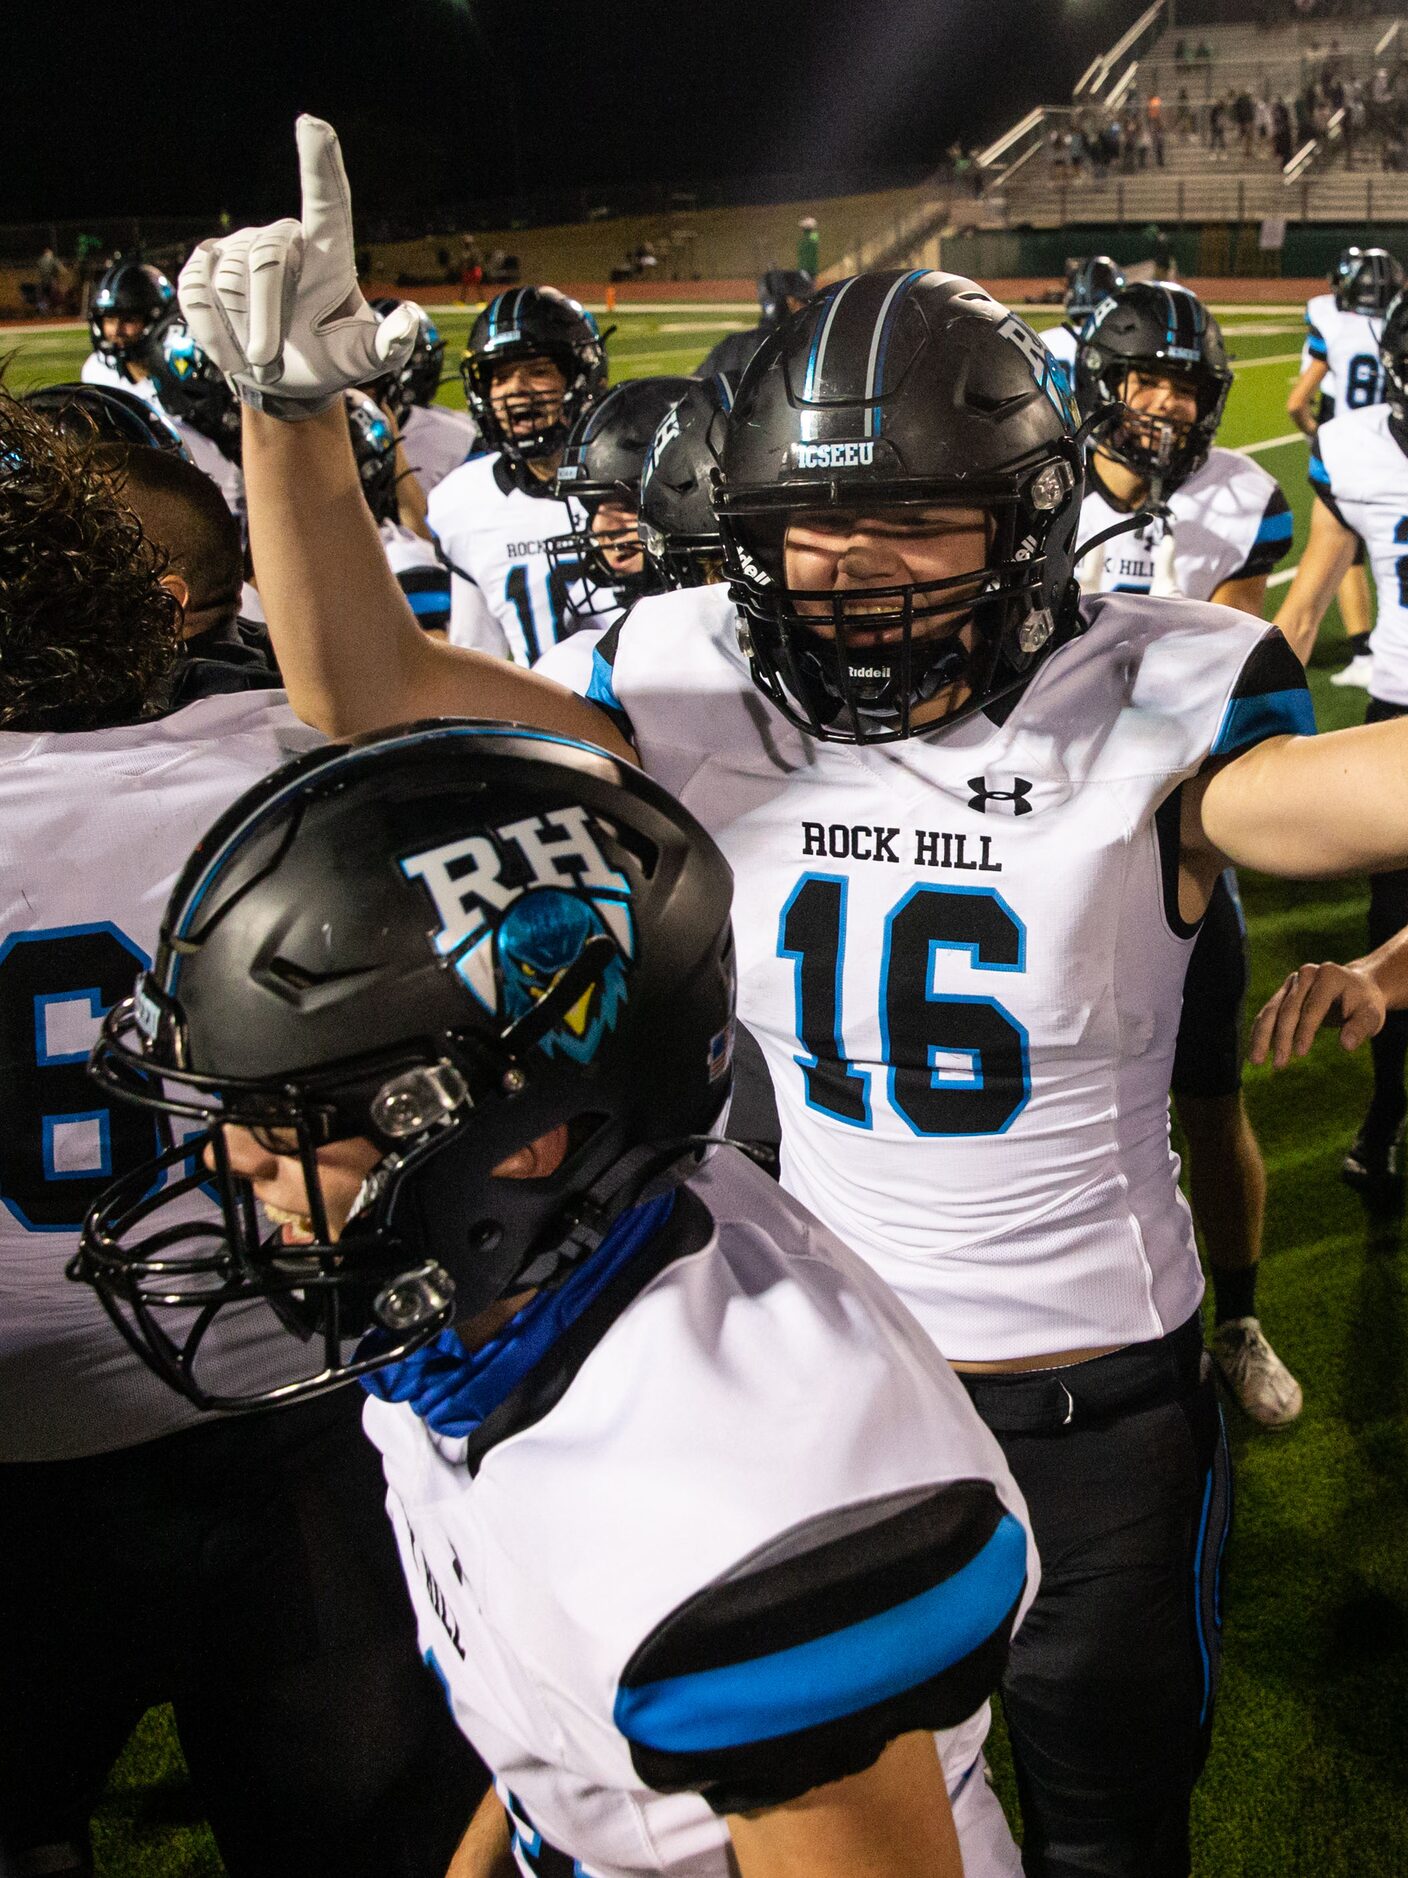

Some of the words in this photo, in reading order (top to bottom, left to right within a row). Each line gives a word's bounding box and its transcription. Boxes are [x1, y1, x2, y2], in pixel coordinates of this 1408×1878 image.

[798, 442, 875, 469] ICSEEU
[399, 805, 632, 955] RH
[802, 821, 900, 864] ROCK
[914, 829, 1003, 872] HILL
[776, 871, 1033, 1138] 16
